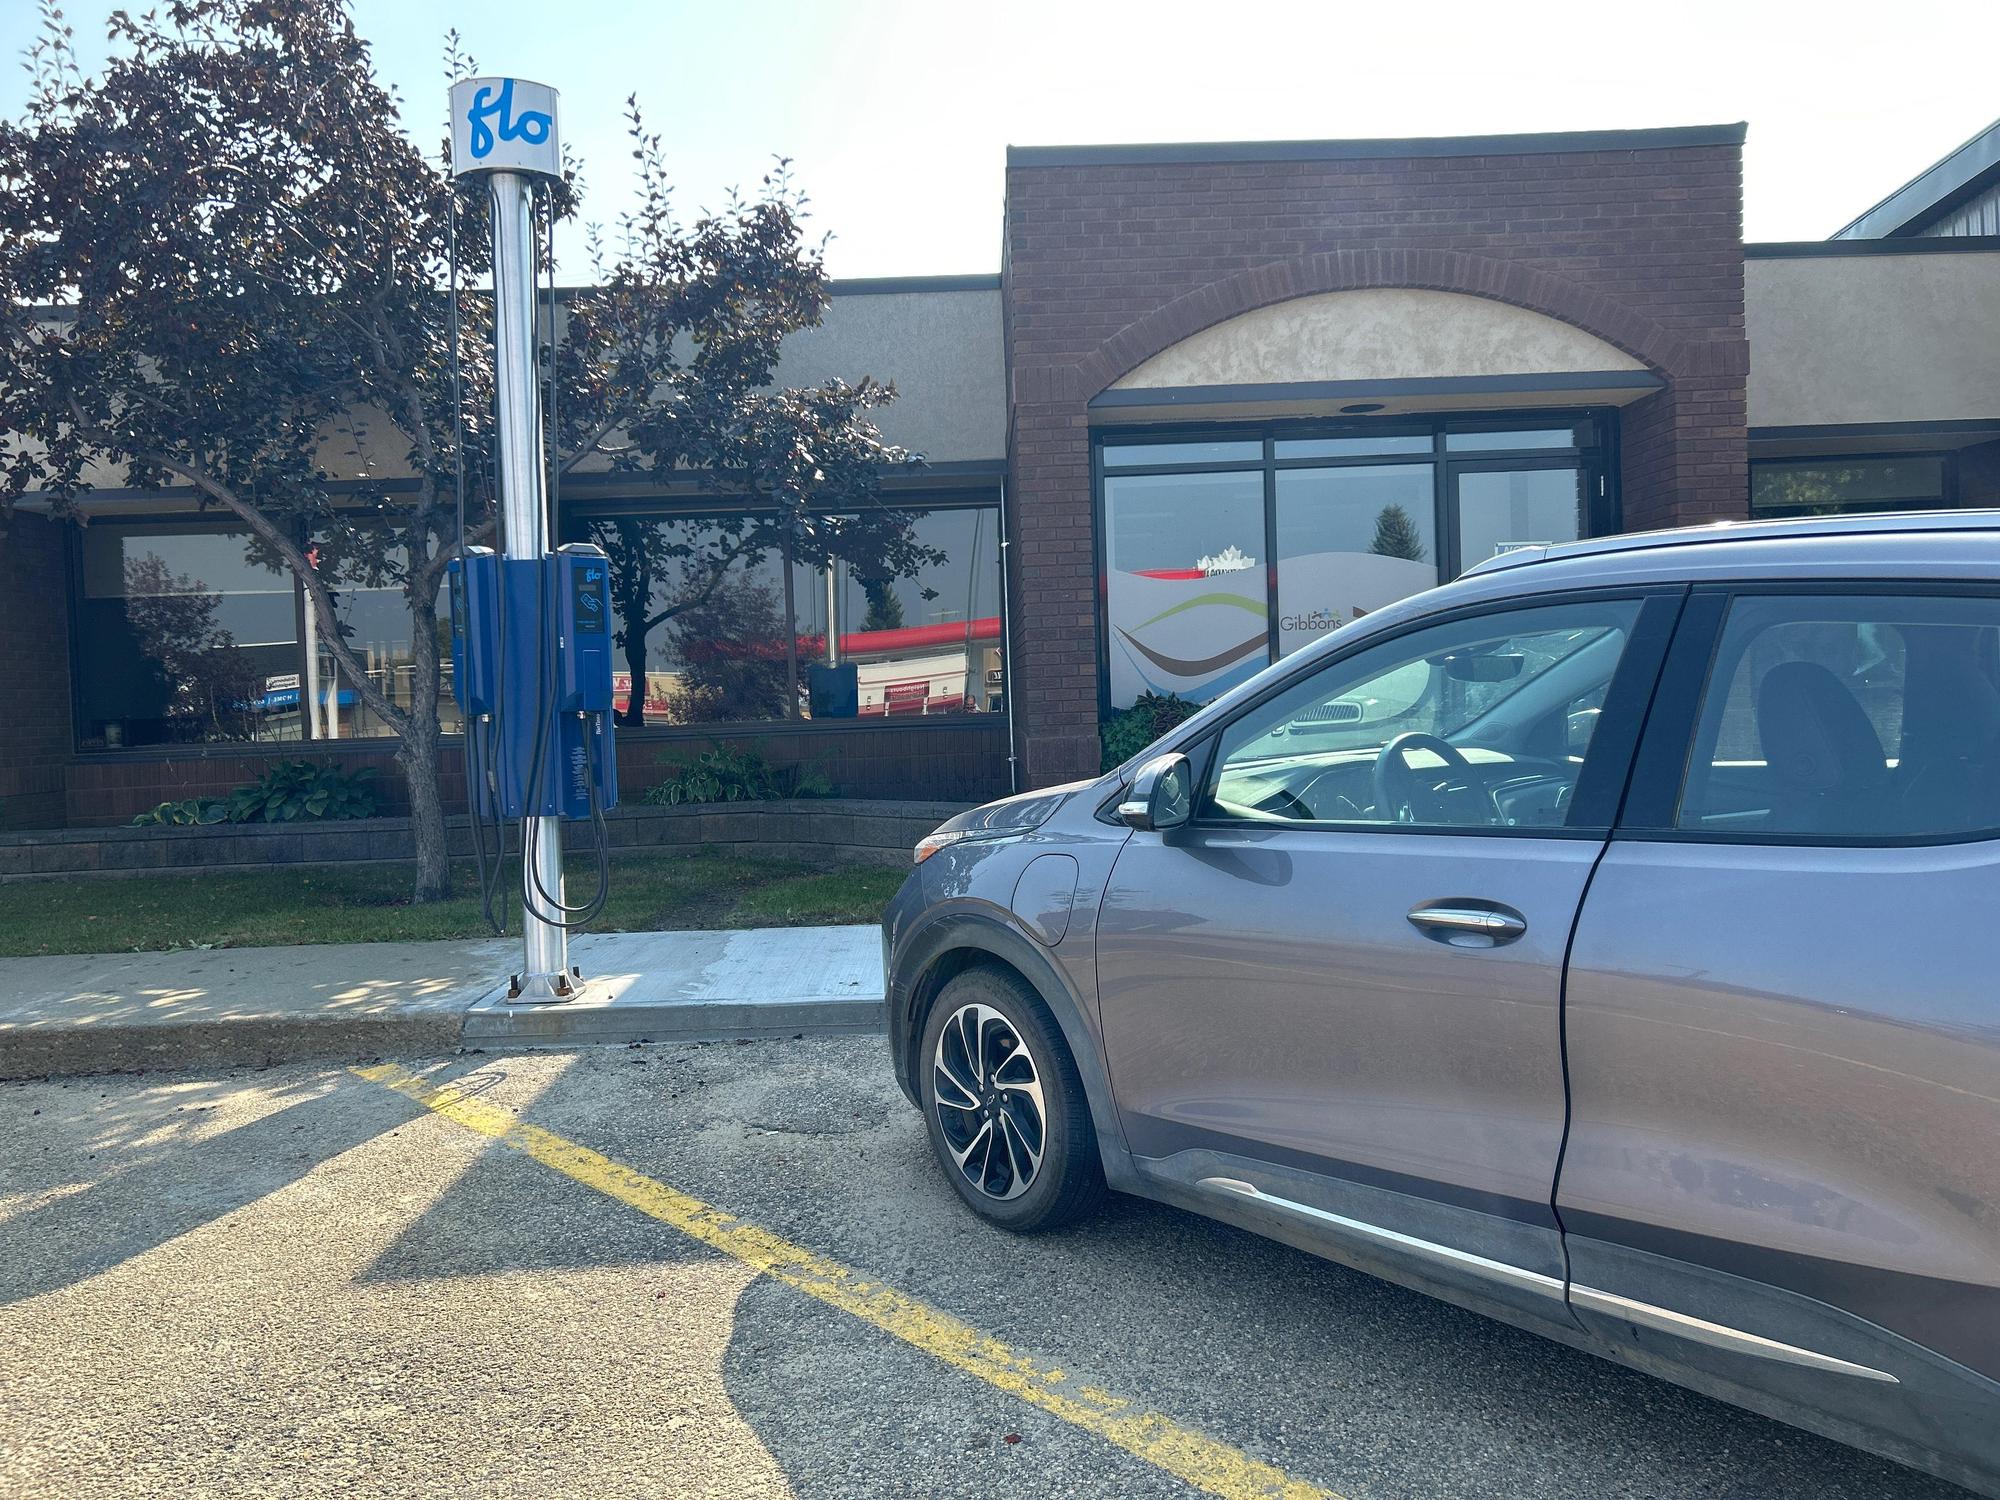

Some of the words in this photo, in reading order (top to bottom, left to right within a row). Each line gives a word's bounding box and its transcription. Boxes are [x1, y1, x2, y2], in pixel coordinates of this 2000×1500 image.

[467, 78, 552, 159] flo
[585, 568, 603, 583] flo
[1280, 613, 1342, 631] Gibbons
